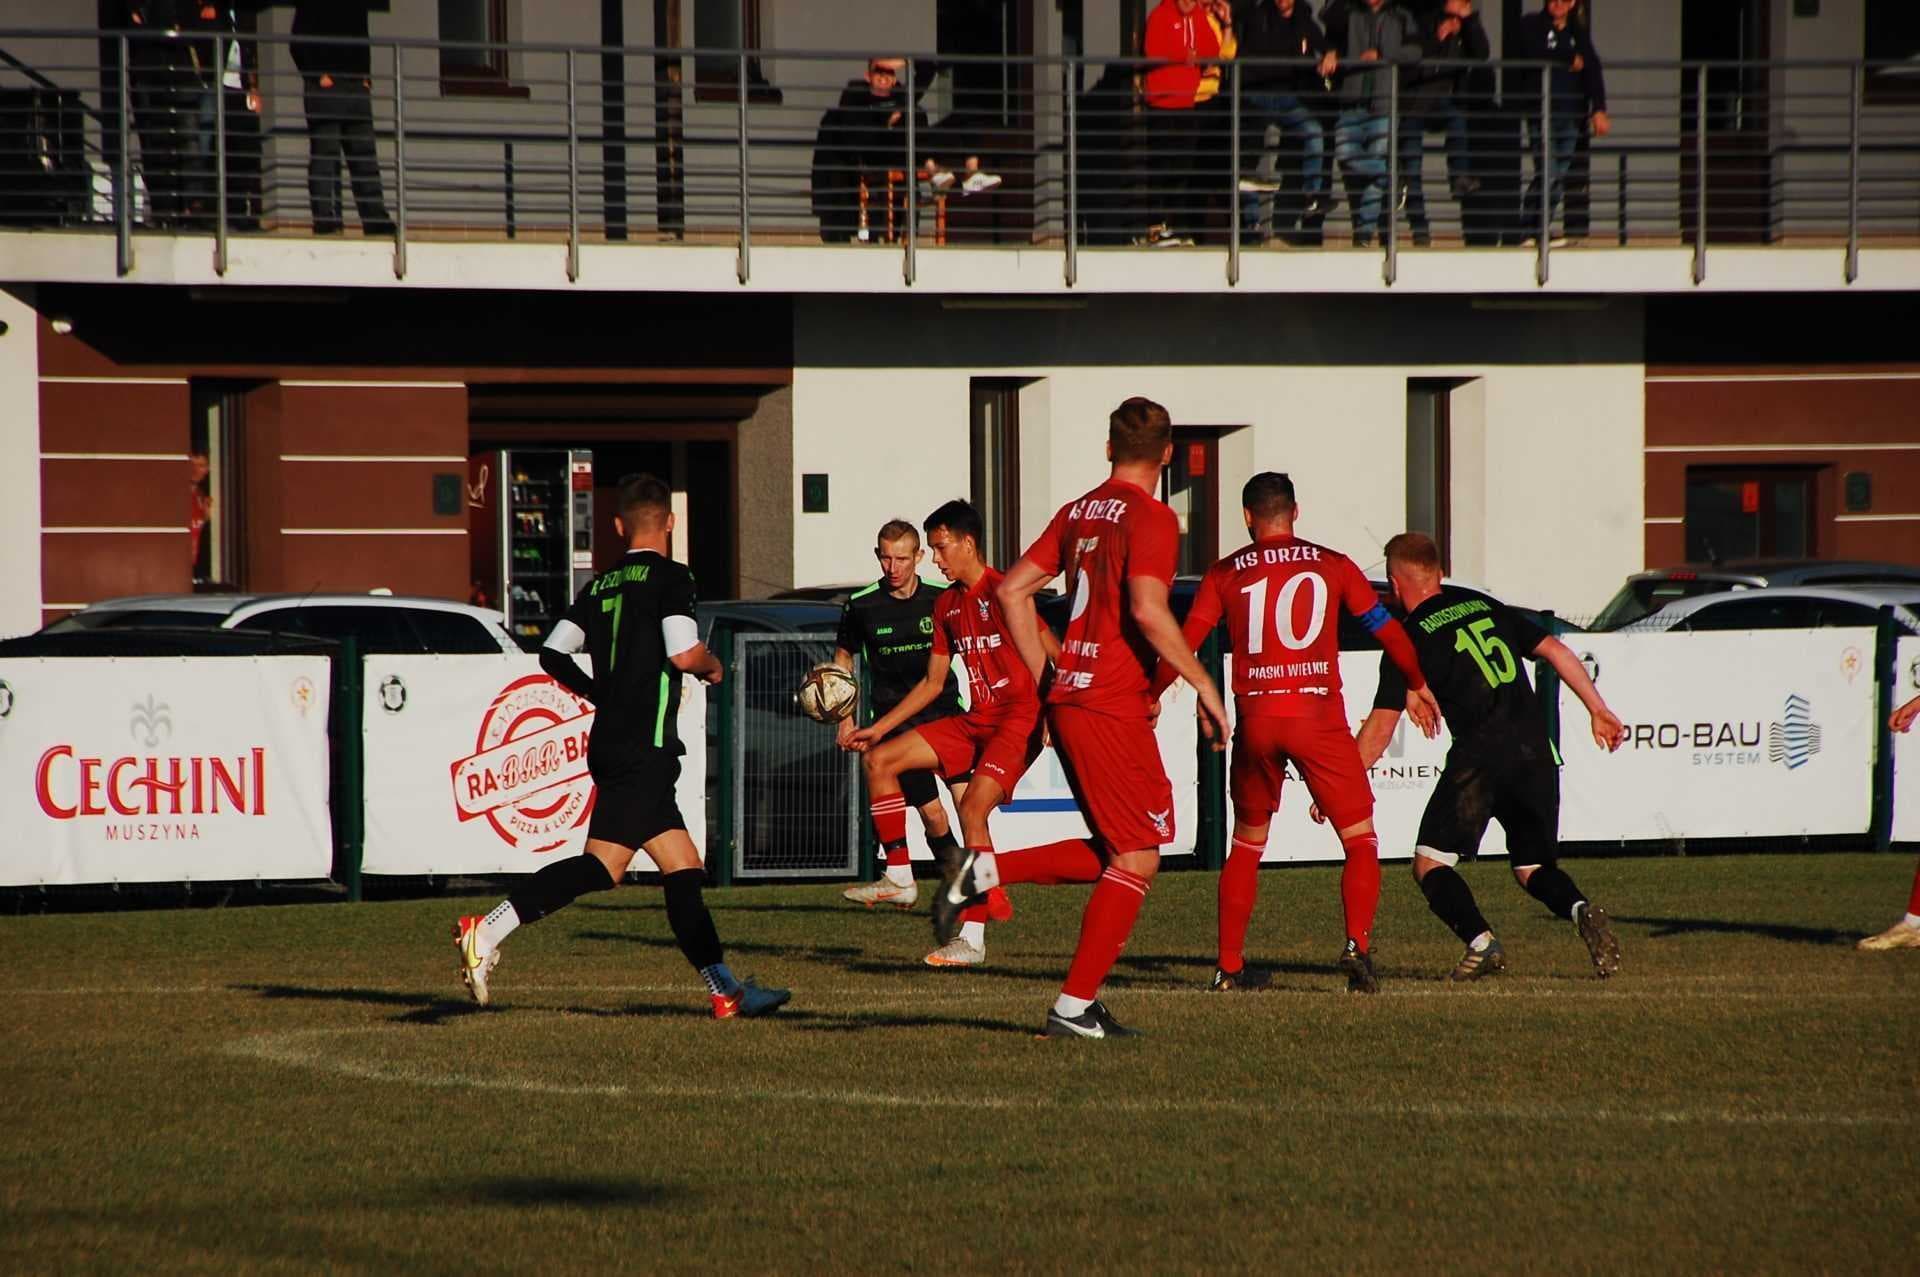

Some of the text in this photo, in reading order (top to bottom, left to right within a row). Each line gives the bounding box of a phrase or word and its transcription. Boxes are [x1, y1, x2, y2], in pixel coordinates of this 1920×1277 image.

[1234, 545, 1321, 571] KS ORZEŁ
[602, 593, 624, 673] 7
[1241, 571, 1328, 655] 10
[1248, 660, 1329, 680] PIASKI WIELKIE
[1454, 616, 1517, 689] 15
[1691, 752, 1761, 766] SYSTEM
[35, 744, 266, 820] CECHINI
[105, 824, 201, 841] MUSZYNA
[509, 814, 540, 835] PIZZA
[553, 791, 584, 830] LUNCH
